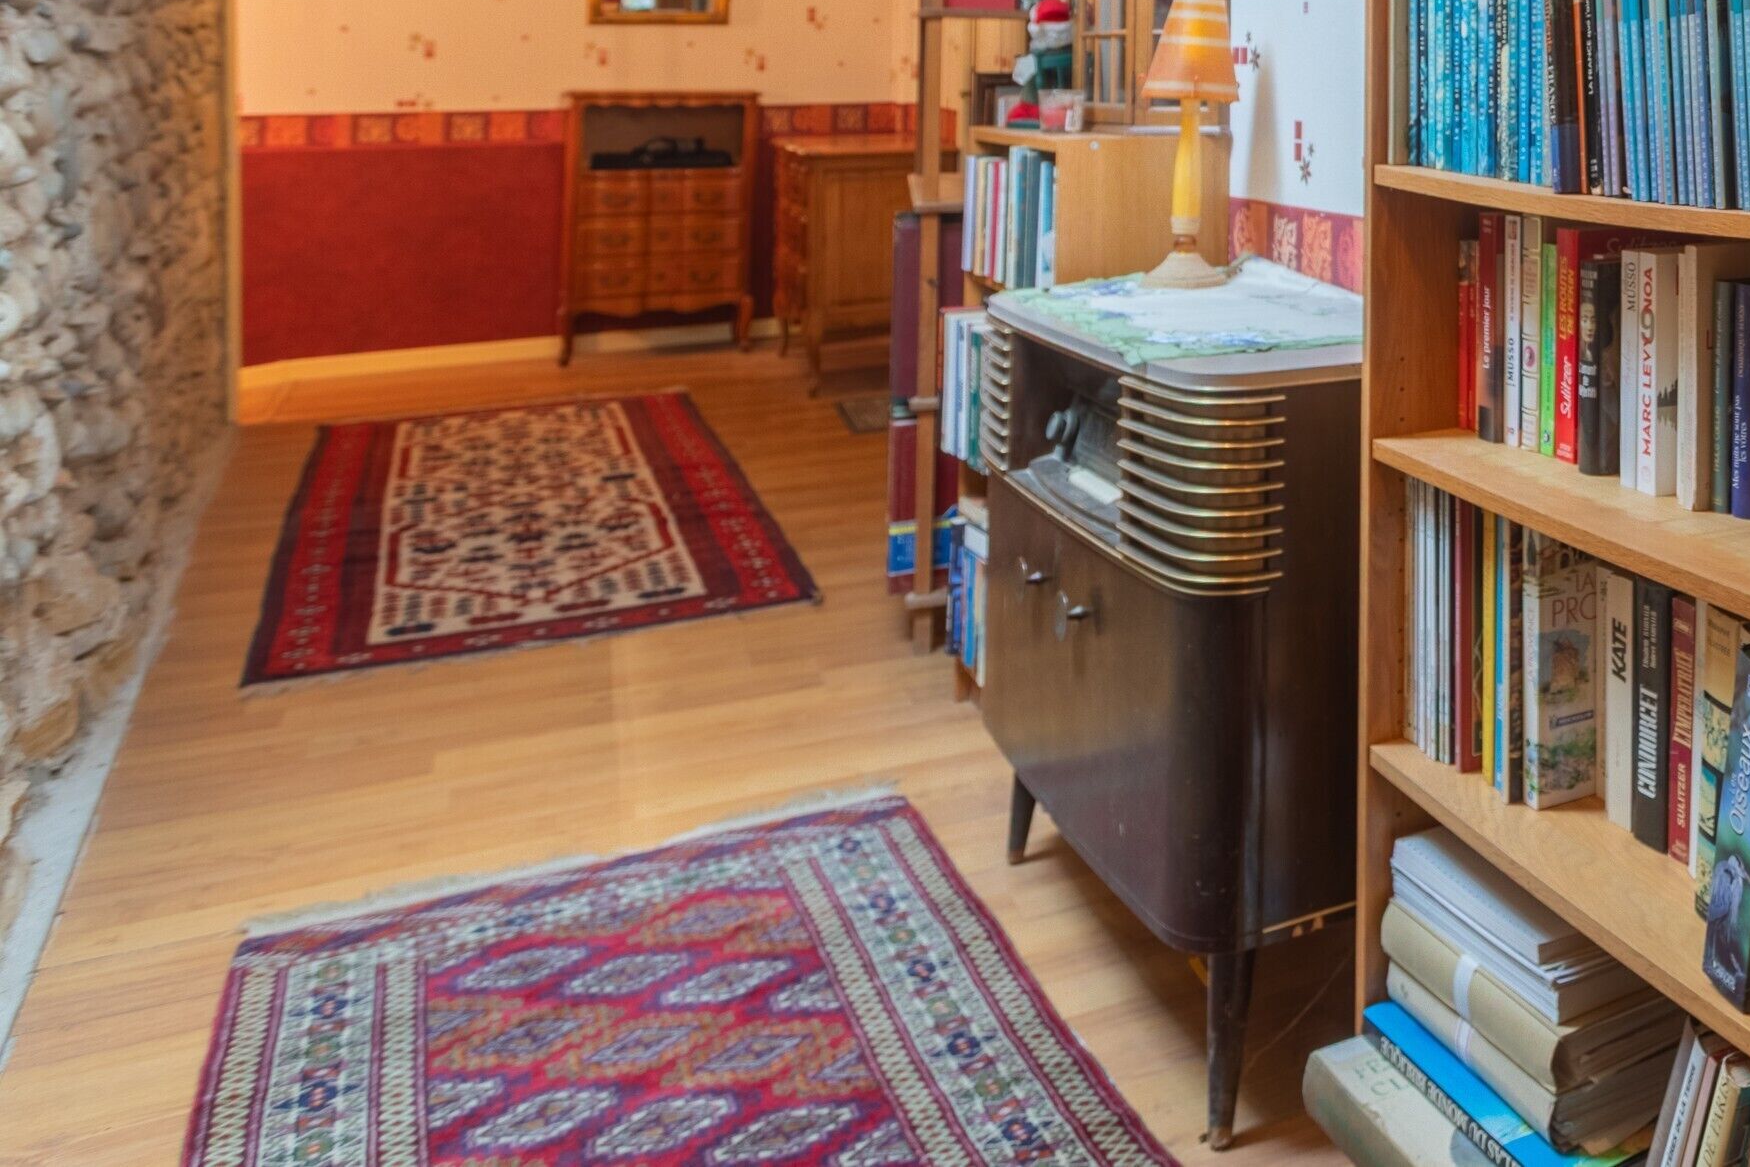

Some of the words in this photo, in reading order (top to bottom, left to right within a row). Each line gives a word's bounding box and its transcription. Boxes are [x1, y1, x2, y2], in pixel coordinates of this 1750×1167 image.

[1585, 38, 1595, 80] FRANCE
[1586, 82, 1595, 95] LA
[1482, 286, 1491, 310] jour
[1558, 255, 1568, 312] ROUTES
[1626, 261, 1637, 313] MUSSO
[1481, 312, 1491, 354] premier
[1558, 314, 1568, 340] LES
[1482, 357, 1491, 369] Le
[1506, 337, 1515, 381] MUSSO
[1642, 337, 1652, 389] LEVY
[1559, 355, 1573, 418] Sulitzer
[1734, 394, 1743, 410] pas
[1642, 395, 1651, 457] MARC
[1732, 469, 1740, 489] Mes
[1611, 617, 1628, 683] KATE
[1637, 683, 1659, 800] CONDORCET
[1675, 763, 1687, 829] SULITZER
[1728, 772, 1737, 795] Les
